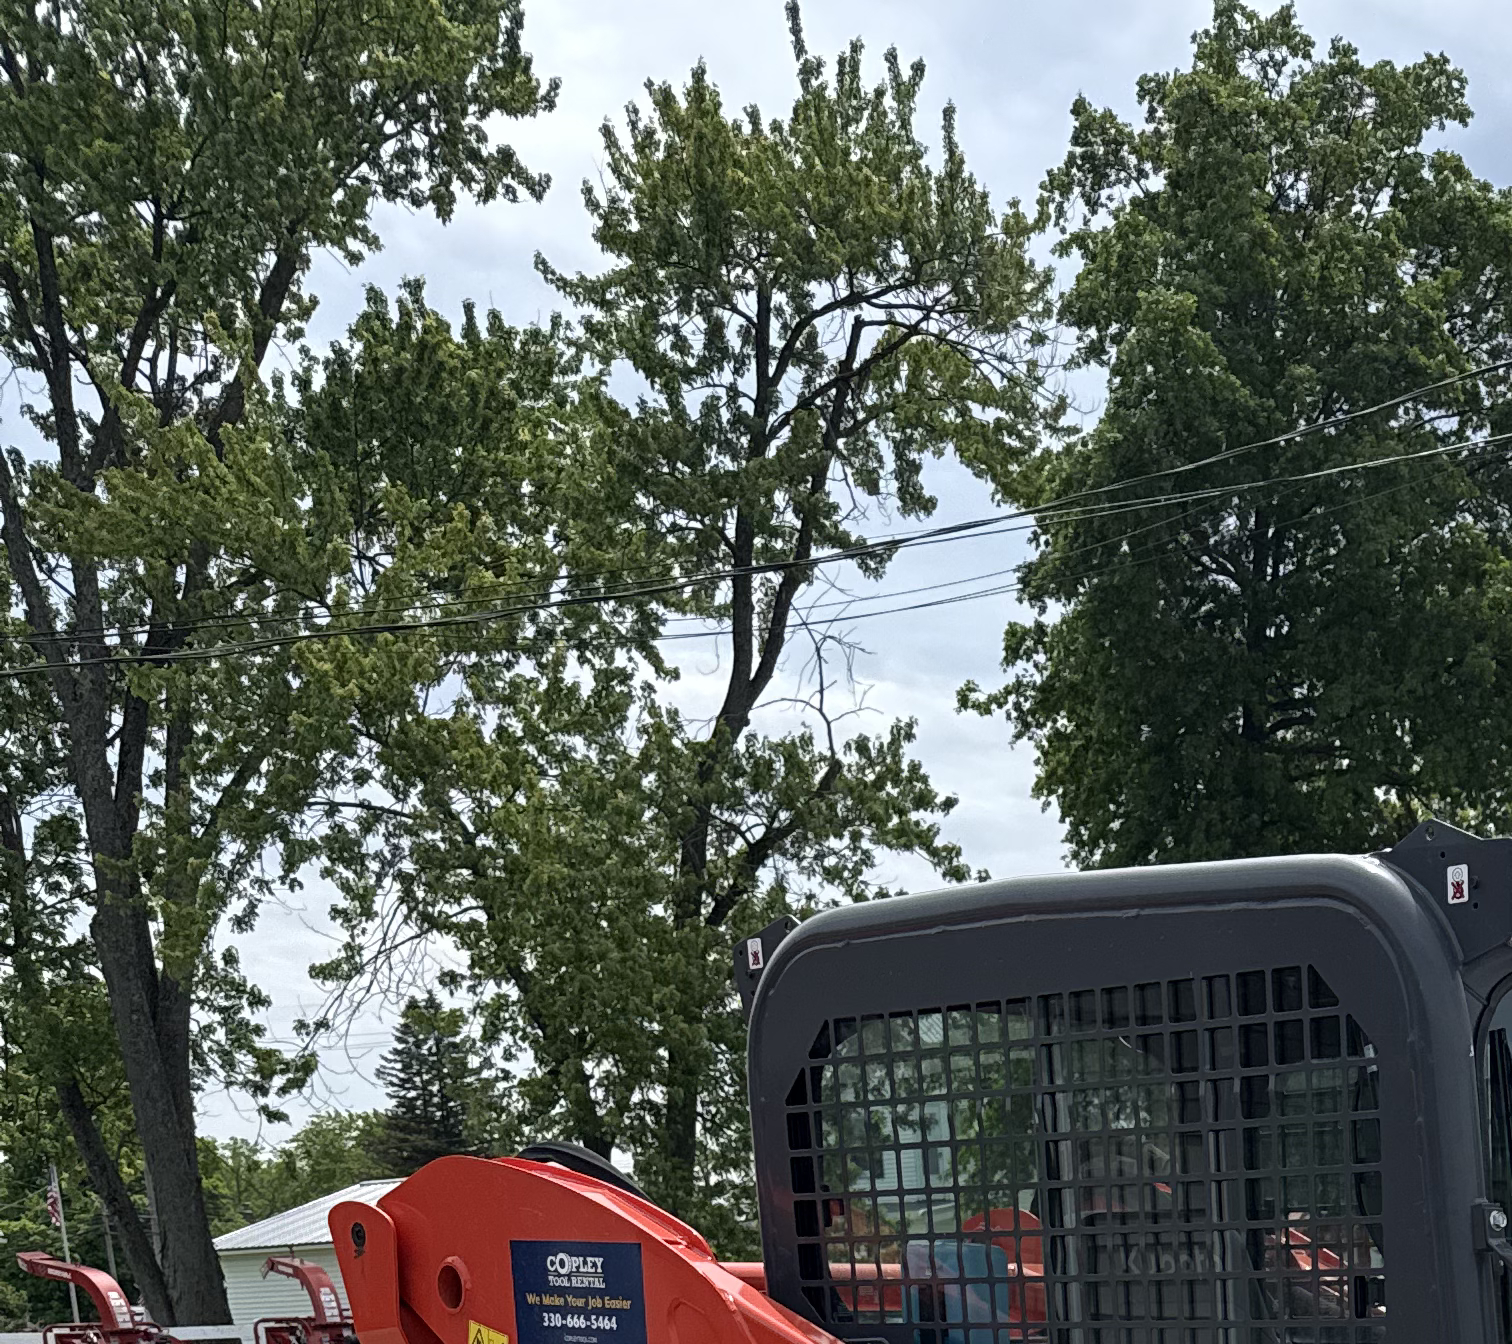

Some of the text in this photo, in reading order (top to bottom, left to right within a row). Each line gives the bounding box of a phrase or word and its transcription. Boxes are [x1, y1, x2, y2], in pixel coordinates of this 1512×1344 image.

[546, 1252, 604, 1275] COPLEY
[548, 1276, 606, 1288] TOOL RENTAL
[525, 1293, 632, 1310] We Make Your Job Easier
[542, 1312, 618, 1331] 330-666-5464
